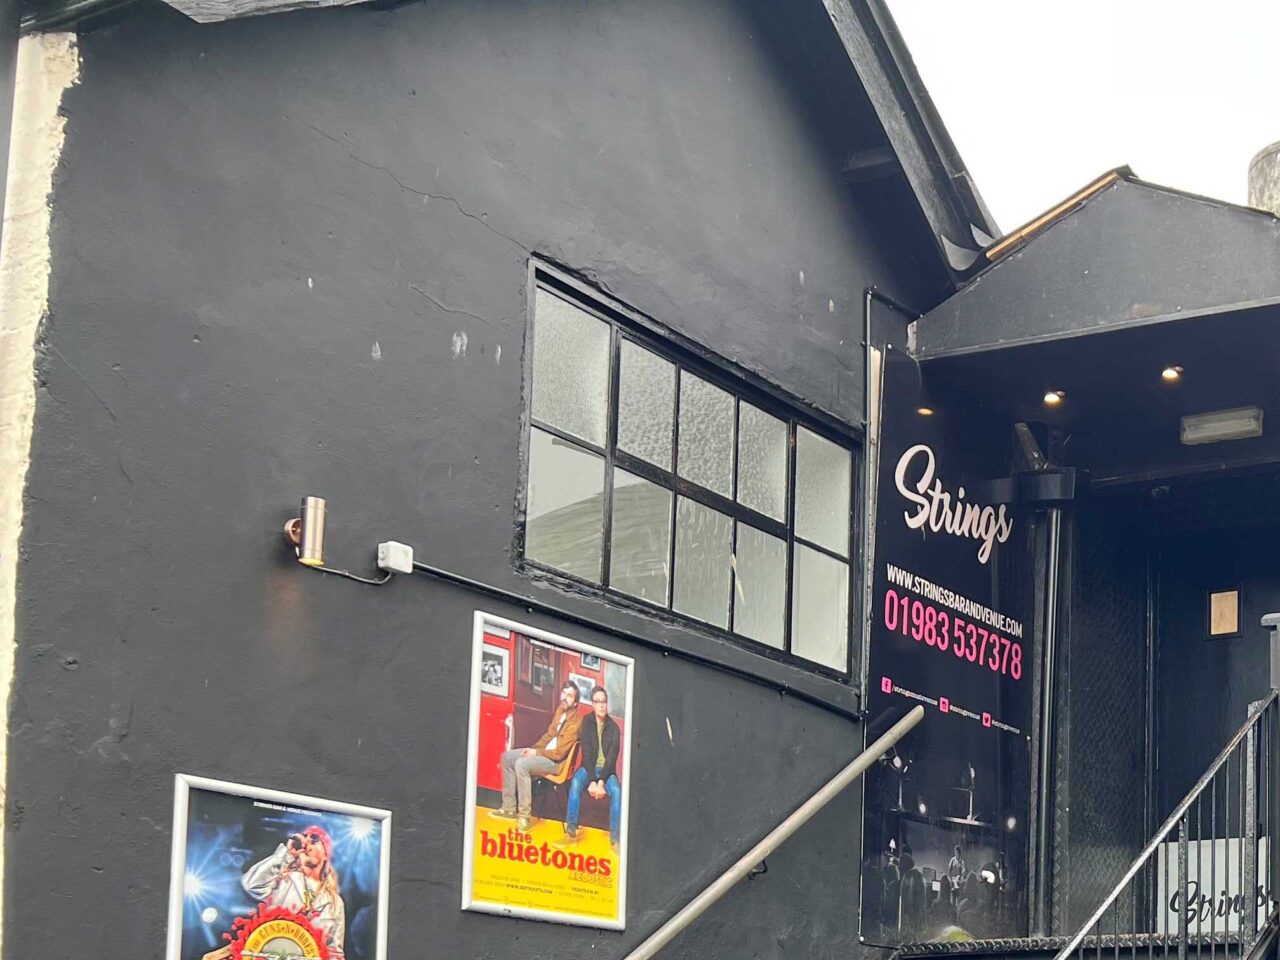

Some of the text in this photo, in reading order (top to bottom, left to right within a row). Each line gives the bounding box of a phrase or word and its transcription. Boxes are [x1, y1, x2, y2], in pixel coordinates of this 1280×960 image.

[894, 444, 1013, 564] Strings
[886, 563, 1023, 639] WWW.STRINGSBARANDVENUE.COM
[884, 589, 1022, 680] 01983 537378
[480, 830, 612, 876] bluetones
[507, 827, 532, 844] the
[1169, 880, 1269, 928] Strins
